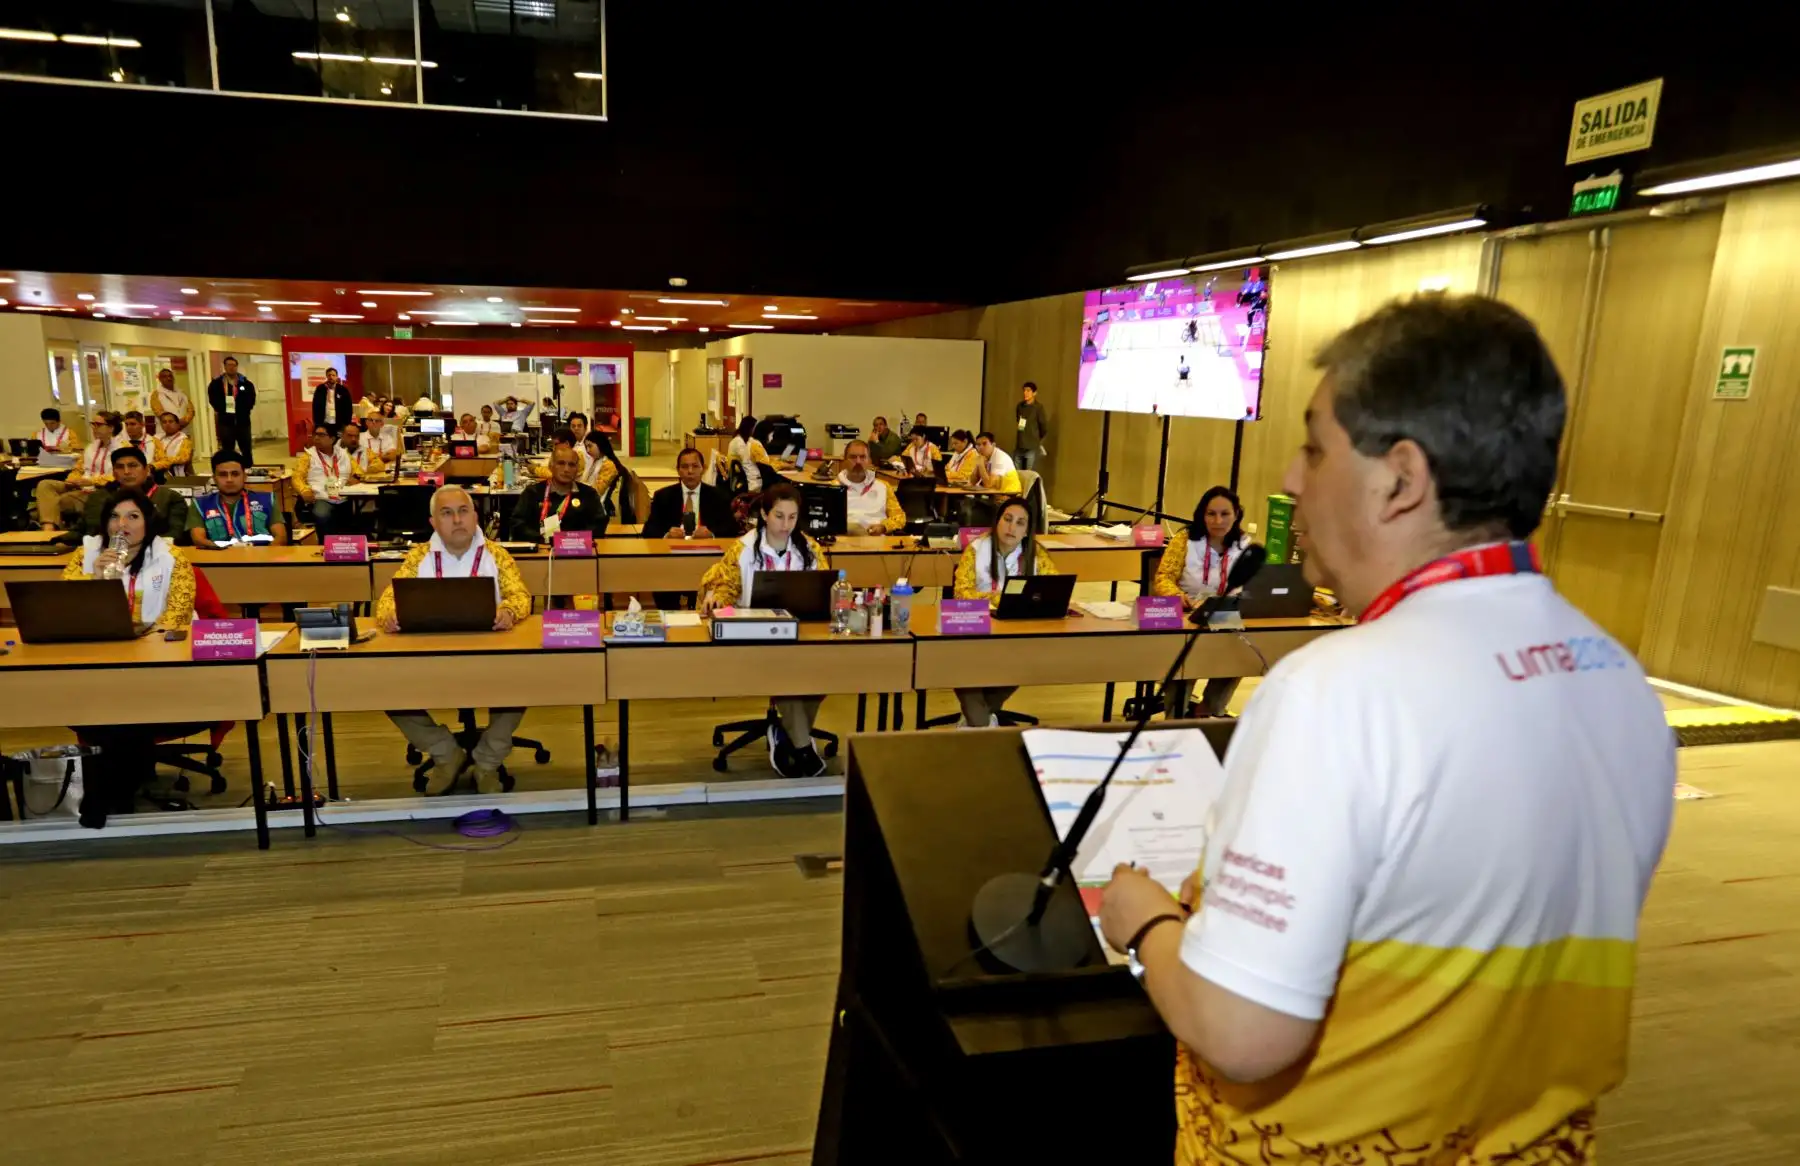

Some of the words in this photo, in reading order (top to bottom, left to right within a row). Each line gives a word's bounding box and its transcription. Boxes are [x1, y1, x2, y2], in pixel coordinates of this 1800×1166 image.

[1579, 97, 1648, 135] SALIDA
[1575, 138, 1586, 150] DE
[1588, 122, 1646, 147] EMERGENCIA
[1573, 189, 1612, 213] SALIDA
[1221, 846, 1287, 881] mericas
